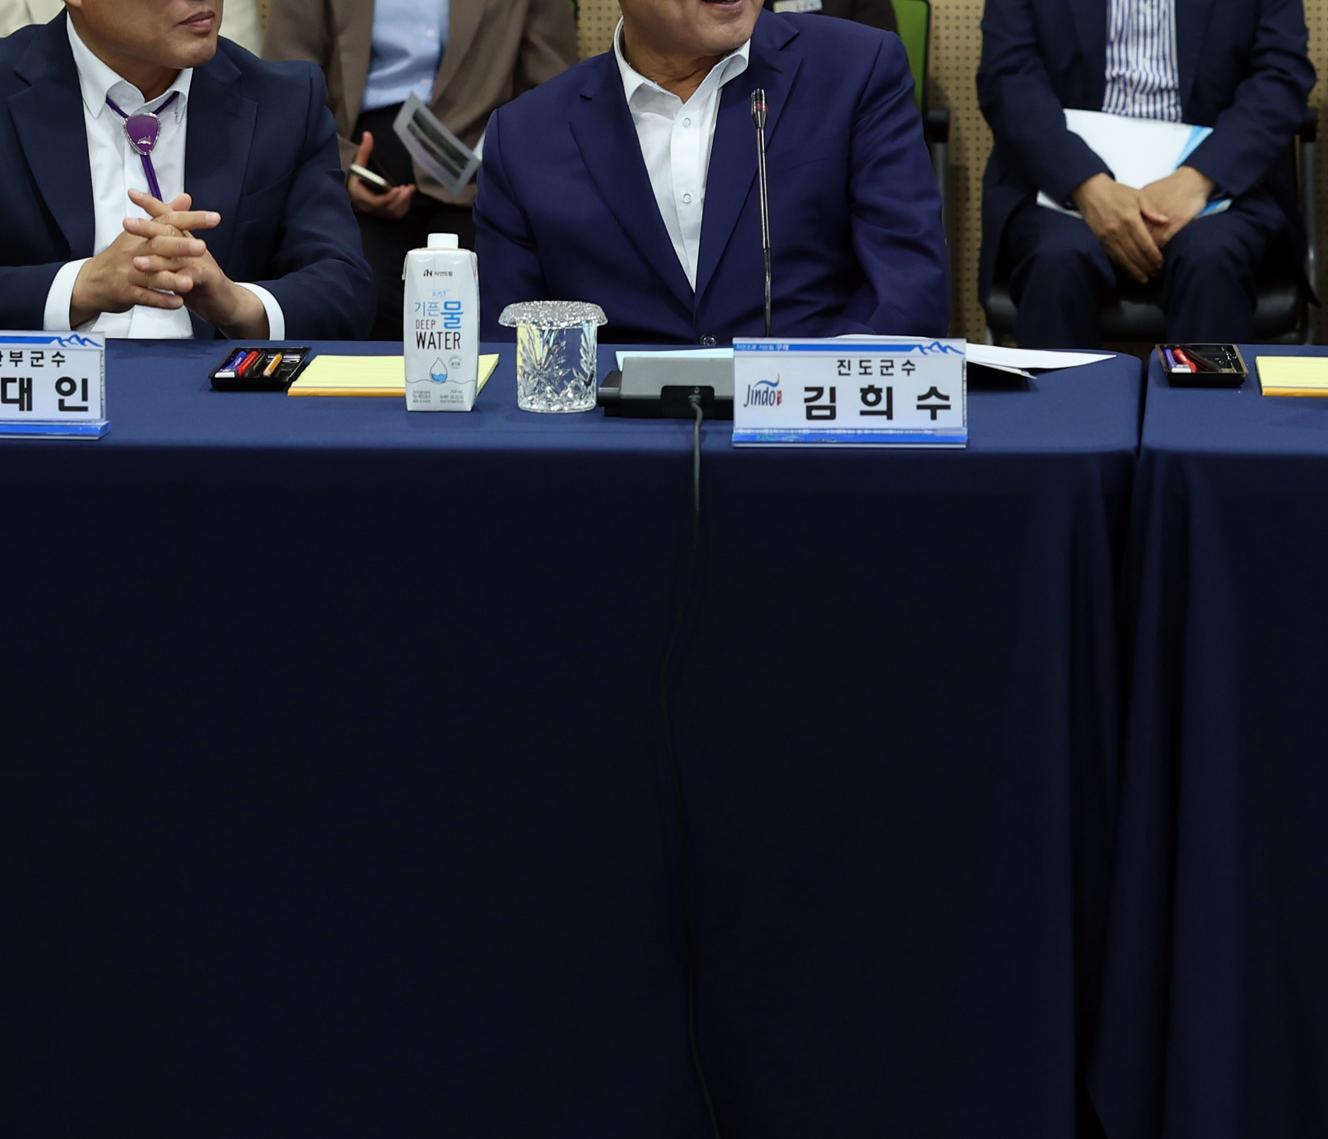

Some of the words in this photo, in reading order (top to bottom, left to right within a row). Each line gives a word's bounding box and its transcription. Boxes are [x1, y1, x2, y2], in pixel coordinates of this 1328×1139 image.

[415, 319, 436, 330] DEEP
[415, 331, 461, 350] WATER
[836, 359, 917, 376] 진도군수
[743, 383, 776, 408] Jindo
[803, 384, 952, 421] 김희수
